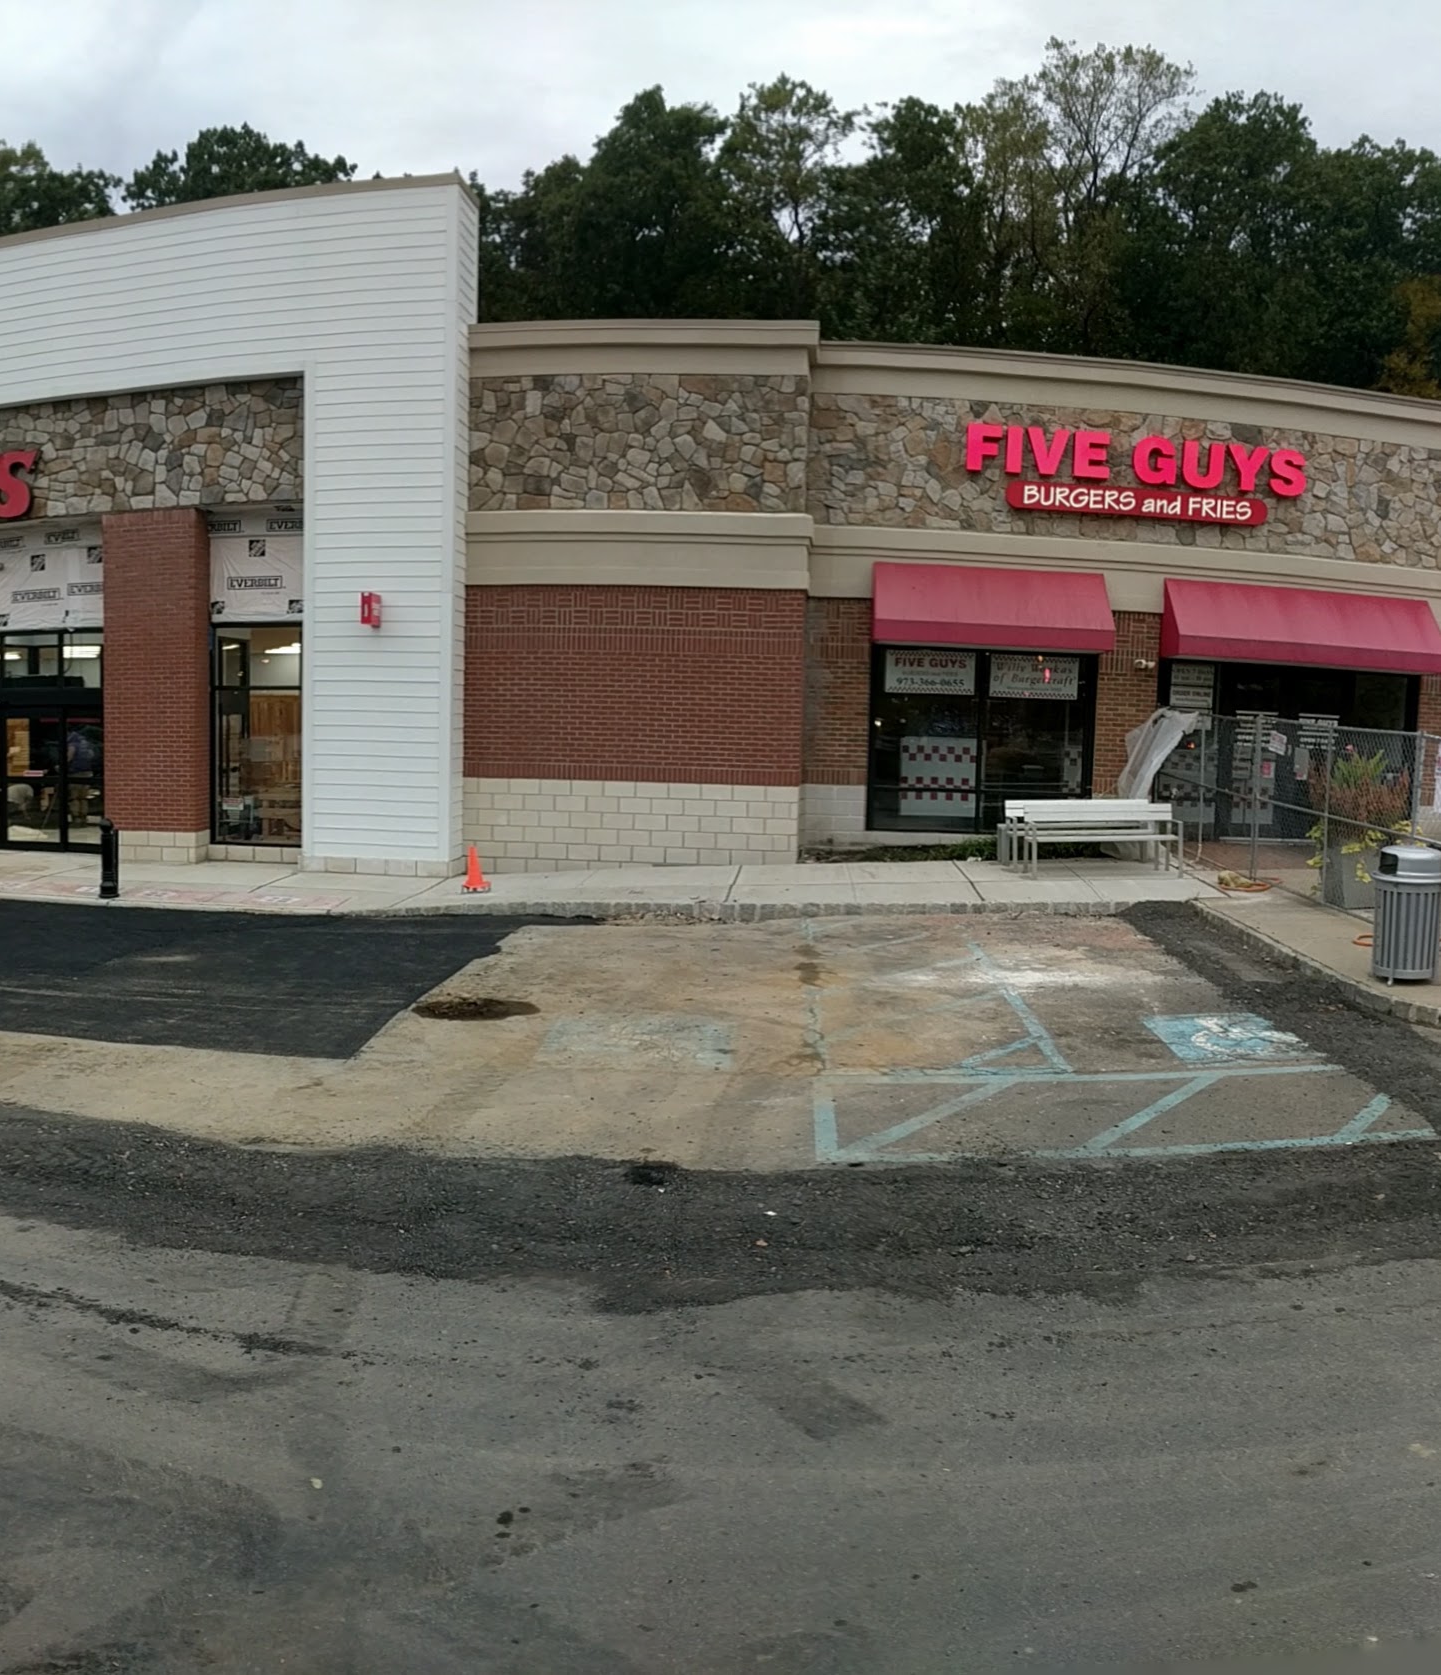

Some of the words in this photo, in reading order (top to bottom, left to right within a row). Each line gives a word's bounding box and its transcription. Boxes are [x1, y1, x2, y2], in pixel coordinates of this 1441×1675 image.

[965, 423, 1111, 480] FIVE
[1132, 435, 1307, 498] GUYS
[1022, 485, 1136, 511] BURGERS
[1141, 495, 1181, 515] and
[1188, 497, 1252, 520] FRIES
[207, 521, 239, 532] RBILT
[229, 577, 280, 589] EVERBILT
[894, 657, 925, 667] FIVE
[929, 658, 967, 669] GUYS
